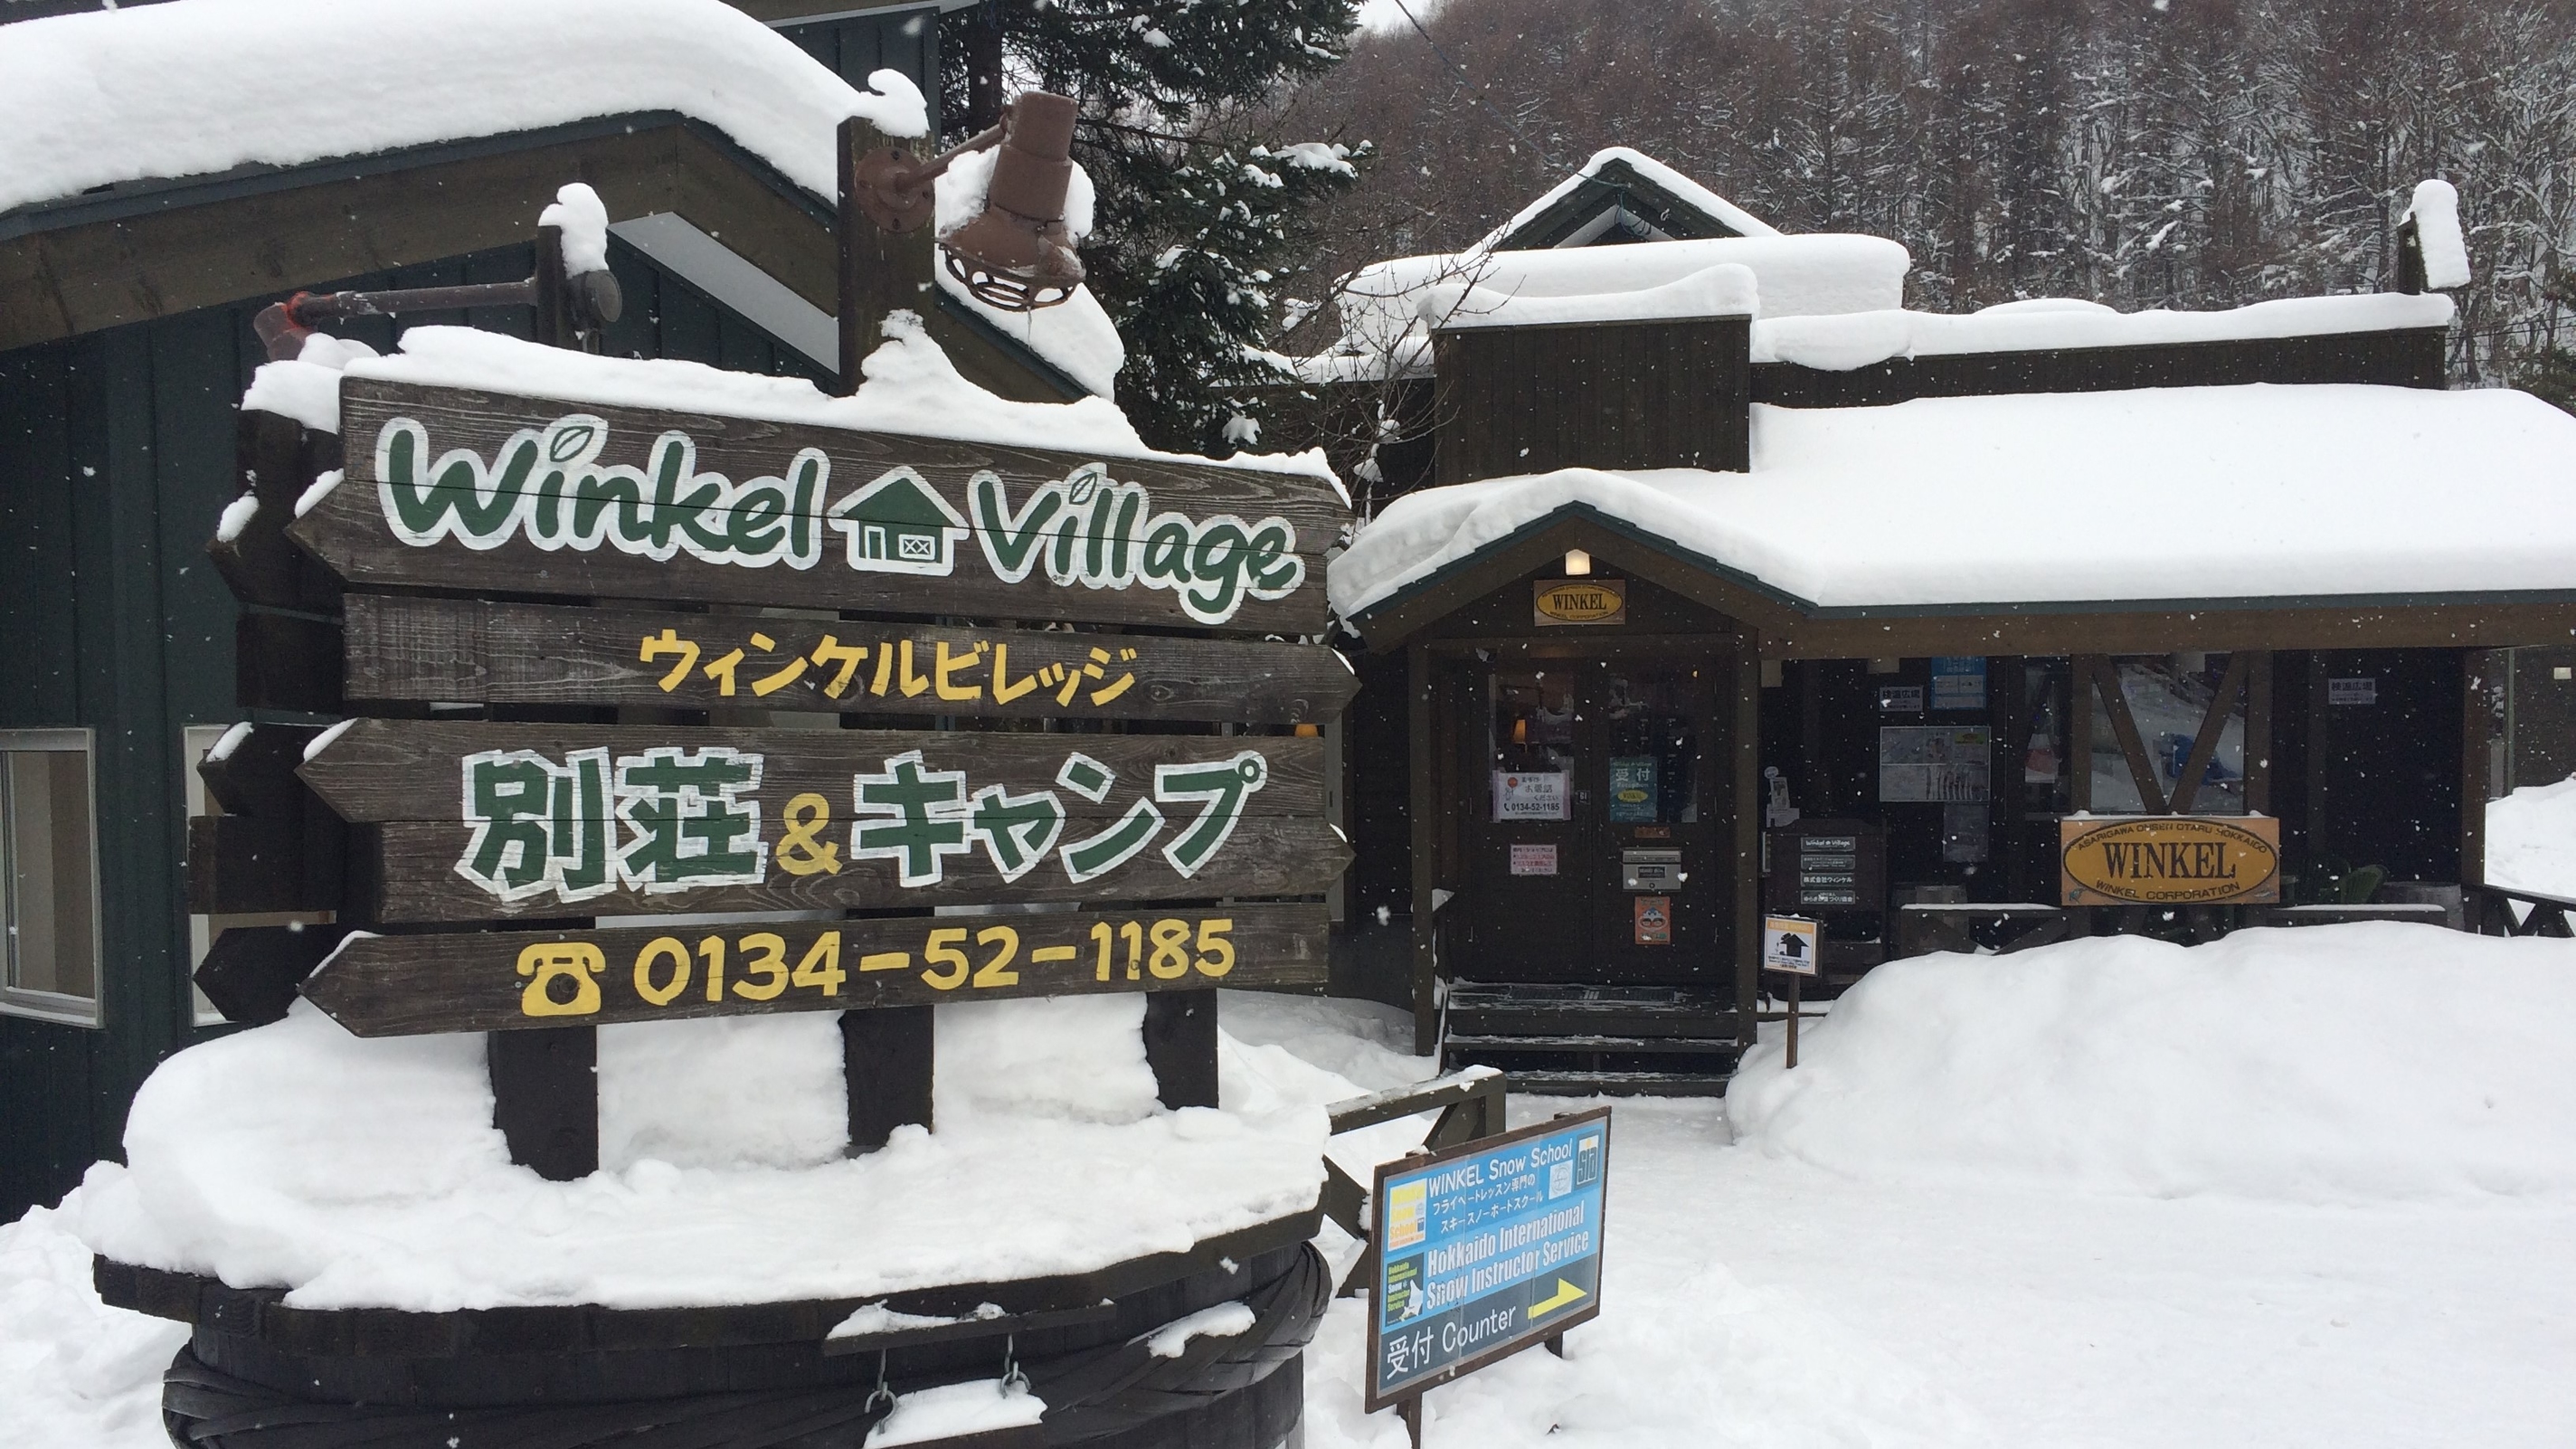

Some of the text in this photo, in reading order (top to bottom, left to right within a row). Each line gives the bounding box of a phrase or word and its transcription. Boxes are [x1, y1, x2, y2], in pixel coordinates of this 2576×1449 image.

[375, 414, 1306, 624] Winkel Village
[1552, 593, 1607, 610] WINKEL
[639, 629, 1137, 706] ウィンケルビレッジ
[1511, 802, 1560, 811] 0134-52-1185
[2078, 825, 2134, 850] ASARIGAWA
[2176, 823, 2212, 834] OTARU
[2096, 880, 2240, 900] WINKEL CORPORATION
[2102, 842, 2236, 878] WINKEL
[634, 919, 1235, 1006] 0134-52-1185
[1428, 1164, 1483, 1198] WINKEL
[1489, 1155, 1526, 1179] Snow
[1530, 1138, 1573, 1166] School
[1425, 1230, 1589, 1311] Snow Instructor Service
[1427, 1199, 1585, 1277] Hokkaido International
[1386, 1304, 1516, 1380] 受付 Counter
